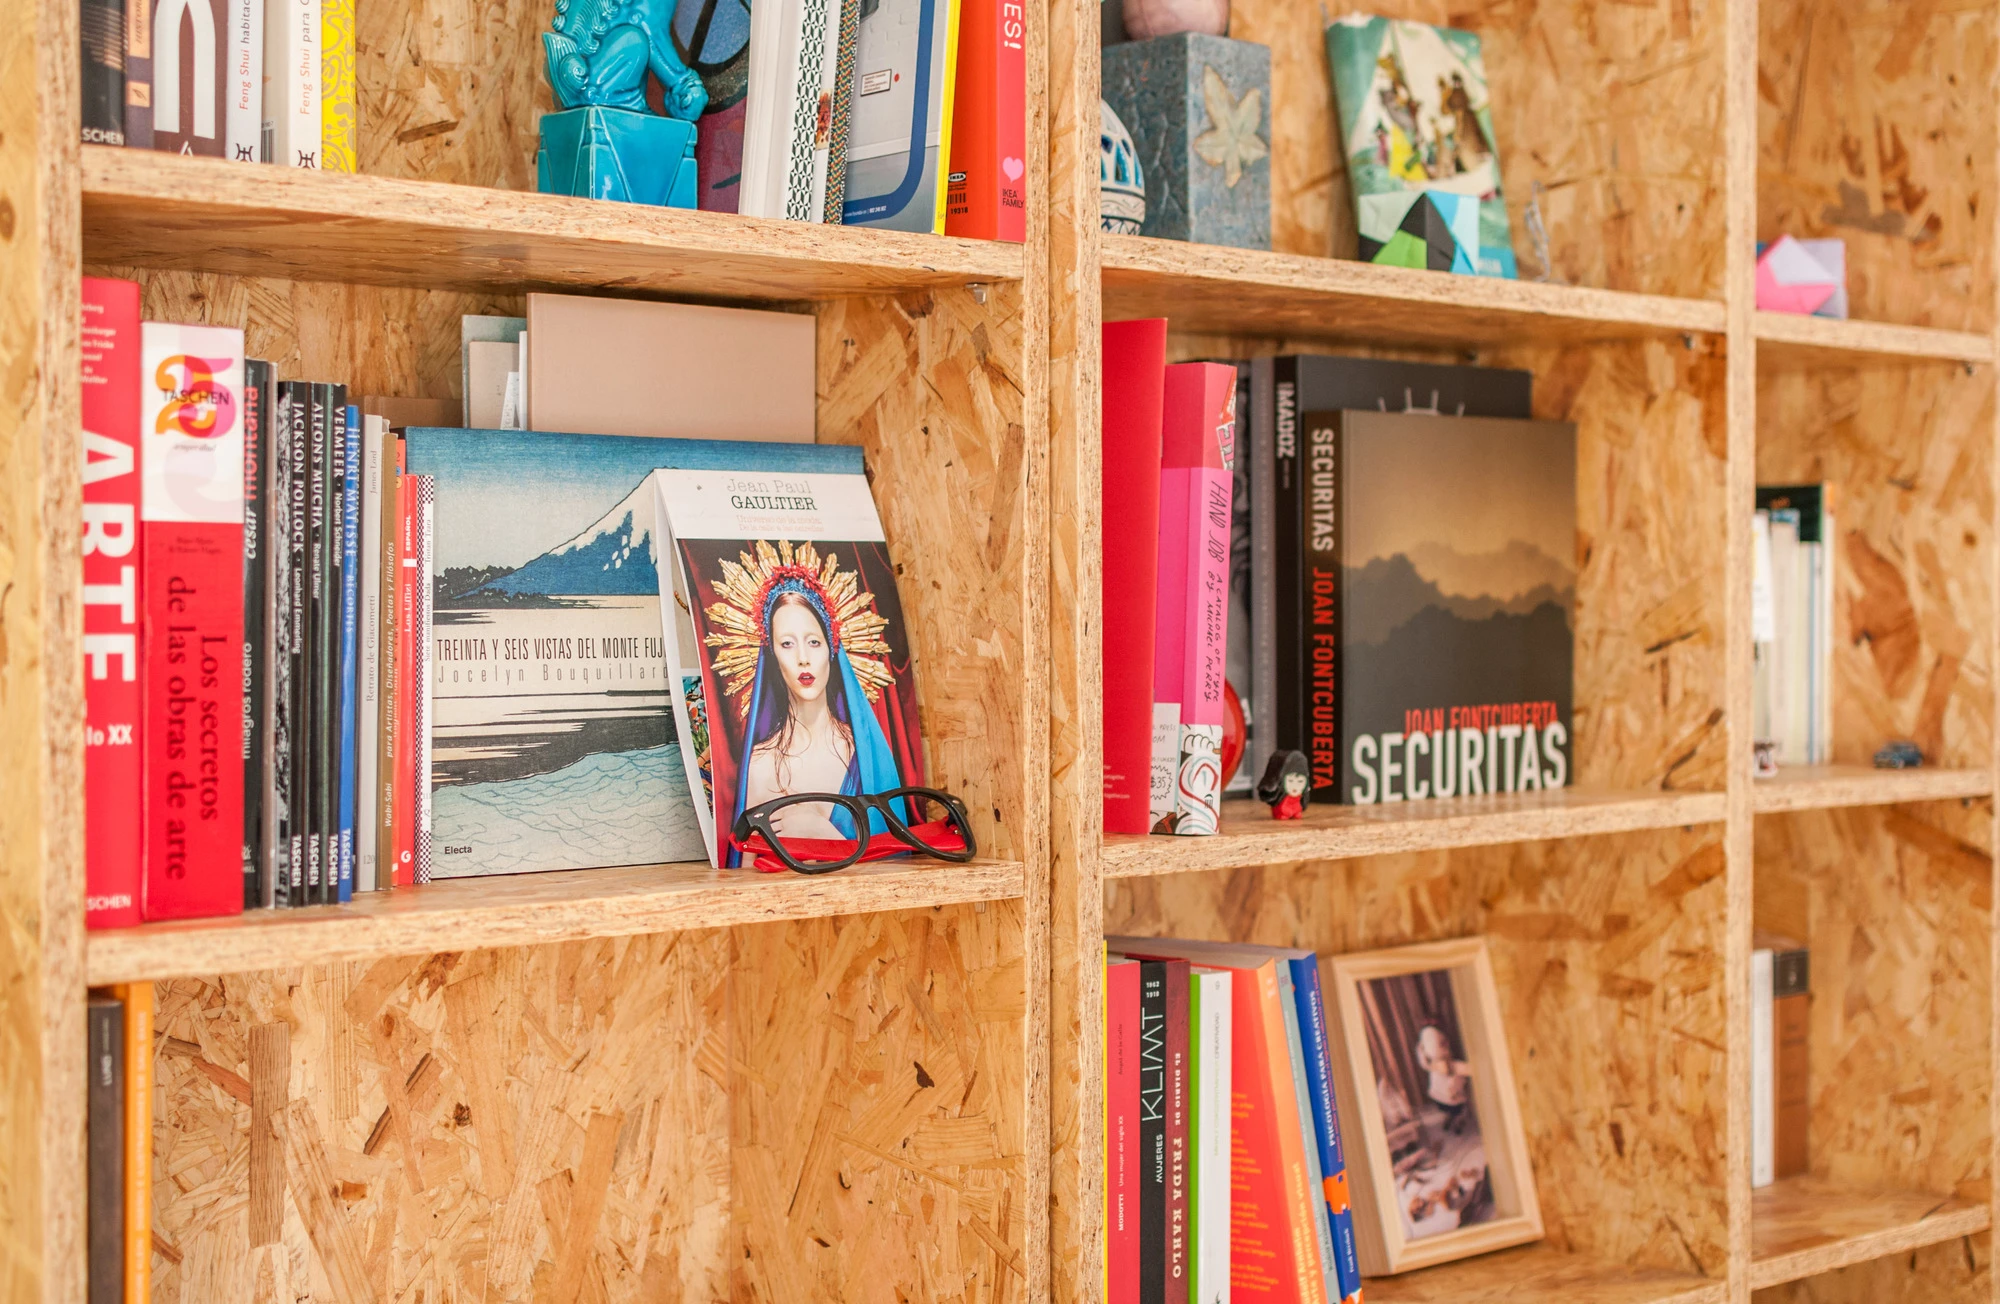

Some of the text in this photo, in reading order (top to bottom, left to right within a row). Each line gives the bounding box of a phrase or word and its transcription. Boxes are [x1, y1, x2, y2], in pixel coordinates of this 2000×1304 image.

[301, 13, 313, 42] para
[240, 0, 252, 110] Feng Shui habitac
[300, 49, 311, 78] Shui
[300, 85, 313, 114] Feng
[1002, 198, 1024, 208] FAMILY
[1003, 189, 1017, 198] IKEA
[162, 388, 230, 405] TASCHEN
[346, 427, 359, 481] HENRI
[312, 402, 324, 599] ALFONS MUCHA Renate Ulmer
[333, 406, 345, 567] VERMEER Norbert Schneider
[727, 478, 812, 494] Jean Paul
[731, 495, 818, 511] GAULTIER
[1208, 480, 1229, 530] HAND
[291, 402, 305, 654] JACKSON POLLOCK Leonhard Emmerling
[346, 488, 358, 557] MATISSE
[404, 514, 412, 551] ESPAÑOL
[82, 429, 136, 682] ARTE
[386, 542, 395, 583] Filósofos
[1207, 530, 1225, 564] JOB
[167, 577, 196, 613] de
[1216, 573, 1223, 583] A
[386, 593, 394, 625] Poetas
[1215, 588, 1223, 641] CATALOG
[1311, 428, 1334, 790] SECURITAS JOAN FONTCUBERTA
[167, 626, 196, 664] las
[366, 594, 376, 702] Retrato de Giacometti
[386, 628, 394, 688] Diseñadores,
[437, 637, 666, 661] TREINTA Y SEIS VISTAS DEL MONTE FUJ
[438, 663, 668, 686] Jocelyn Bouquillard
[166, 676, 196, 760] obras
[200, 635, 228, 821] Los secretos
[385, 691, 394, 733] Artistas,
[1404, 701, 1558, 740] JOAN FONTCUBERTA
[108, 724, 132, 746] XX
[386, 734, 394, 758] para
[1352, 721, 1567, 806] SECURITAS
[166, 771, 196, 808] de
[384, 782, 393, 827] Wabi-Sabi
[165, 820, 187, 880] arte
[291, 834, 302, 888] TASCHEN
[308, 832, 319, 886] TASCHEN
[328, 833, 339, 887] TASCHEN
[340, 828, 352, 880] TASCHEN
[444, 845, 472, 855] Electa
[1141, 1007, 1163, 1121] KLIMT
[1175, 1053, 1181, 1066] EL
[1310, 991, 1336, 1146] PSICOLOGÍA PARA CREATIVOS
[1174, 1111, 1181, 1126] DE
[1155, 1134, 1163, 1183] MUJERES
[1173, 1137, 1182, 1201] FRIDA
[1172, 1208, 1182, 1278] KAHLO
